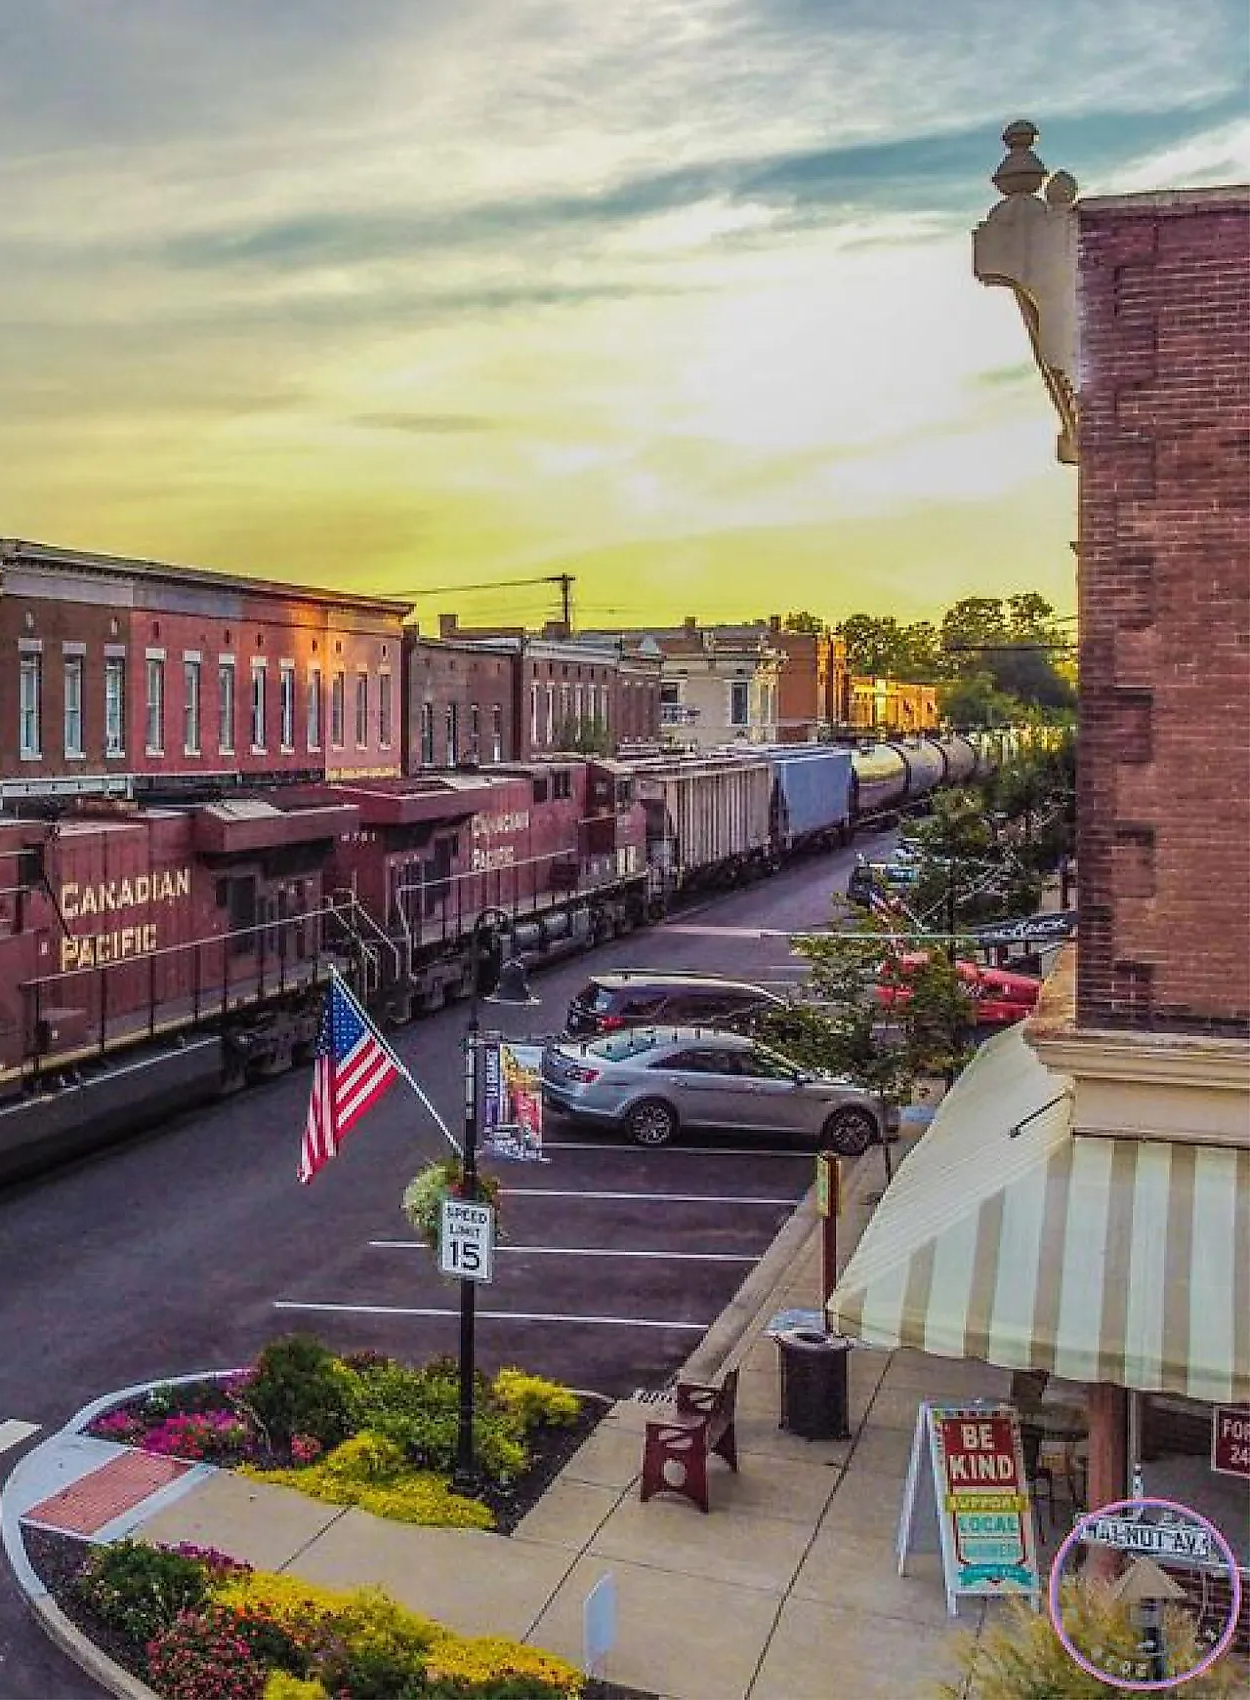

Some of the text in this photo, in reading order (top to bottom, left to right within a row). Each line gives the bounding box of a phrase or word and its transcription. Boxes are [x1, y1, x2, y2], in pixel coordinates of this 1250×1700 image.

[61, 868, 191, 920] CANADIAN
[61, 923, 158, 972] PACIFIC
[447, 1204, 488, 1225] SPEED
[449, 1241, 481, 1271] 15
[961, 1423, 994, 1450] BE
[950, 1454, 1014, 1481] KIND
[958, 1516, 1019, 1532] LOCAL
